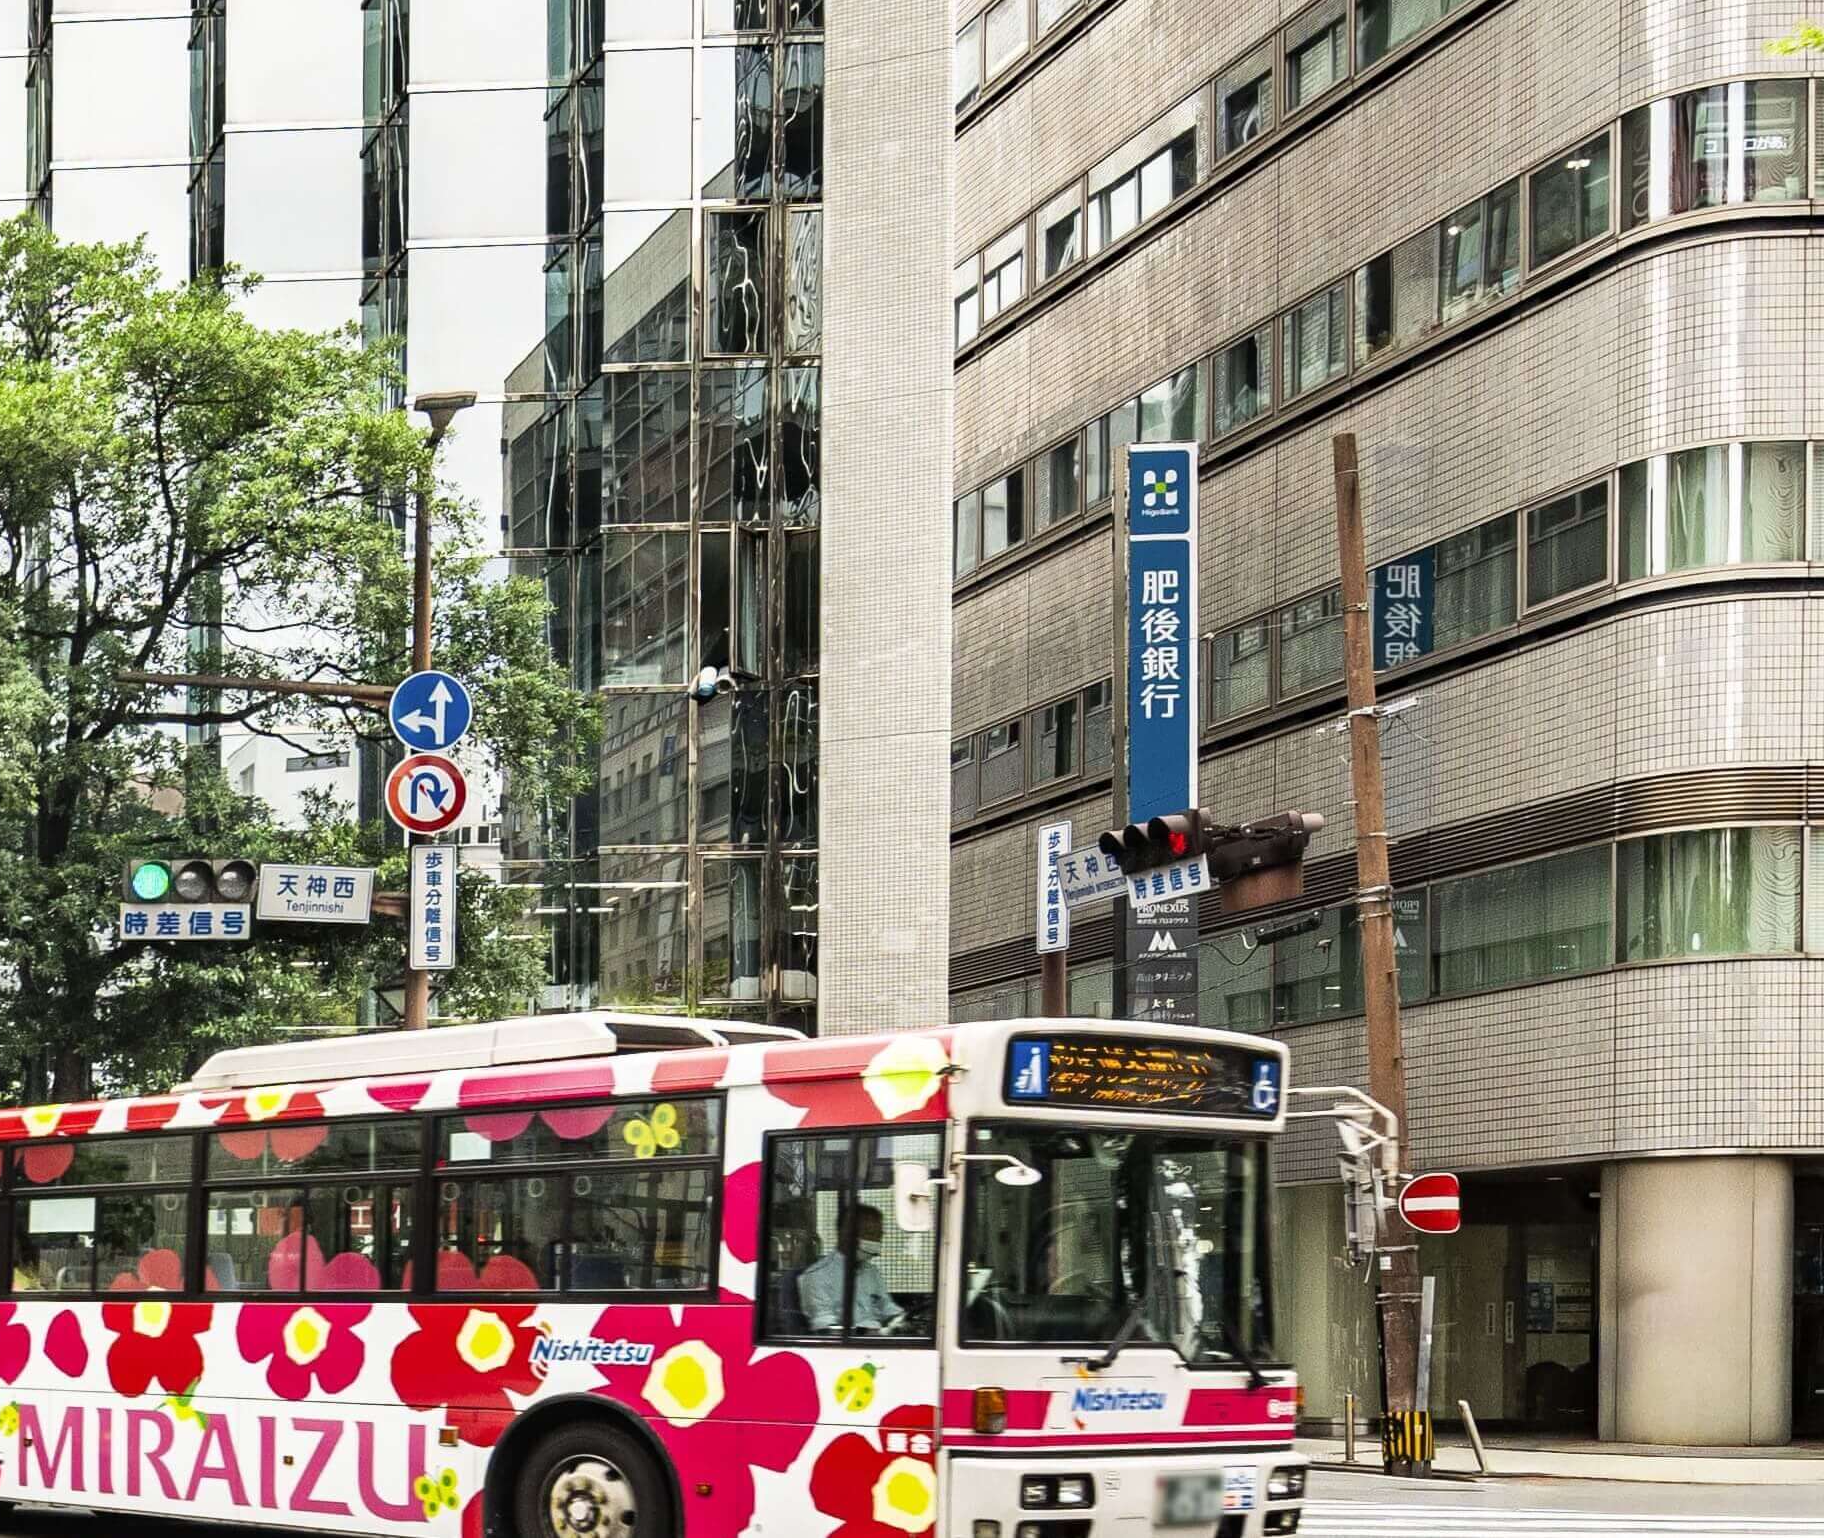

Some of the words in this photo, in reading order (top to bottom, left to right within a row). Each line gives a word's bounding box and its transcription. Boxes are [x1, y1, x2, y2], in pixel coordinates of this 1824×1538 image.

[1140, 569, 1182, 720] 肥後銀行
[276, 873, 356, 899] 天神西
[285, 898, 344, 914] Tenjinnishi
[424, 851, 443, 962] 歩車分離信号
[124, 911, 245, 936] 時差信号
[533, 1338, 651, 1362] Nishitetsu
[1071, 1387, 1168, 1412] Nishitetsu
[17, 1402, 428, 1524] MIRAIZU
